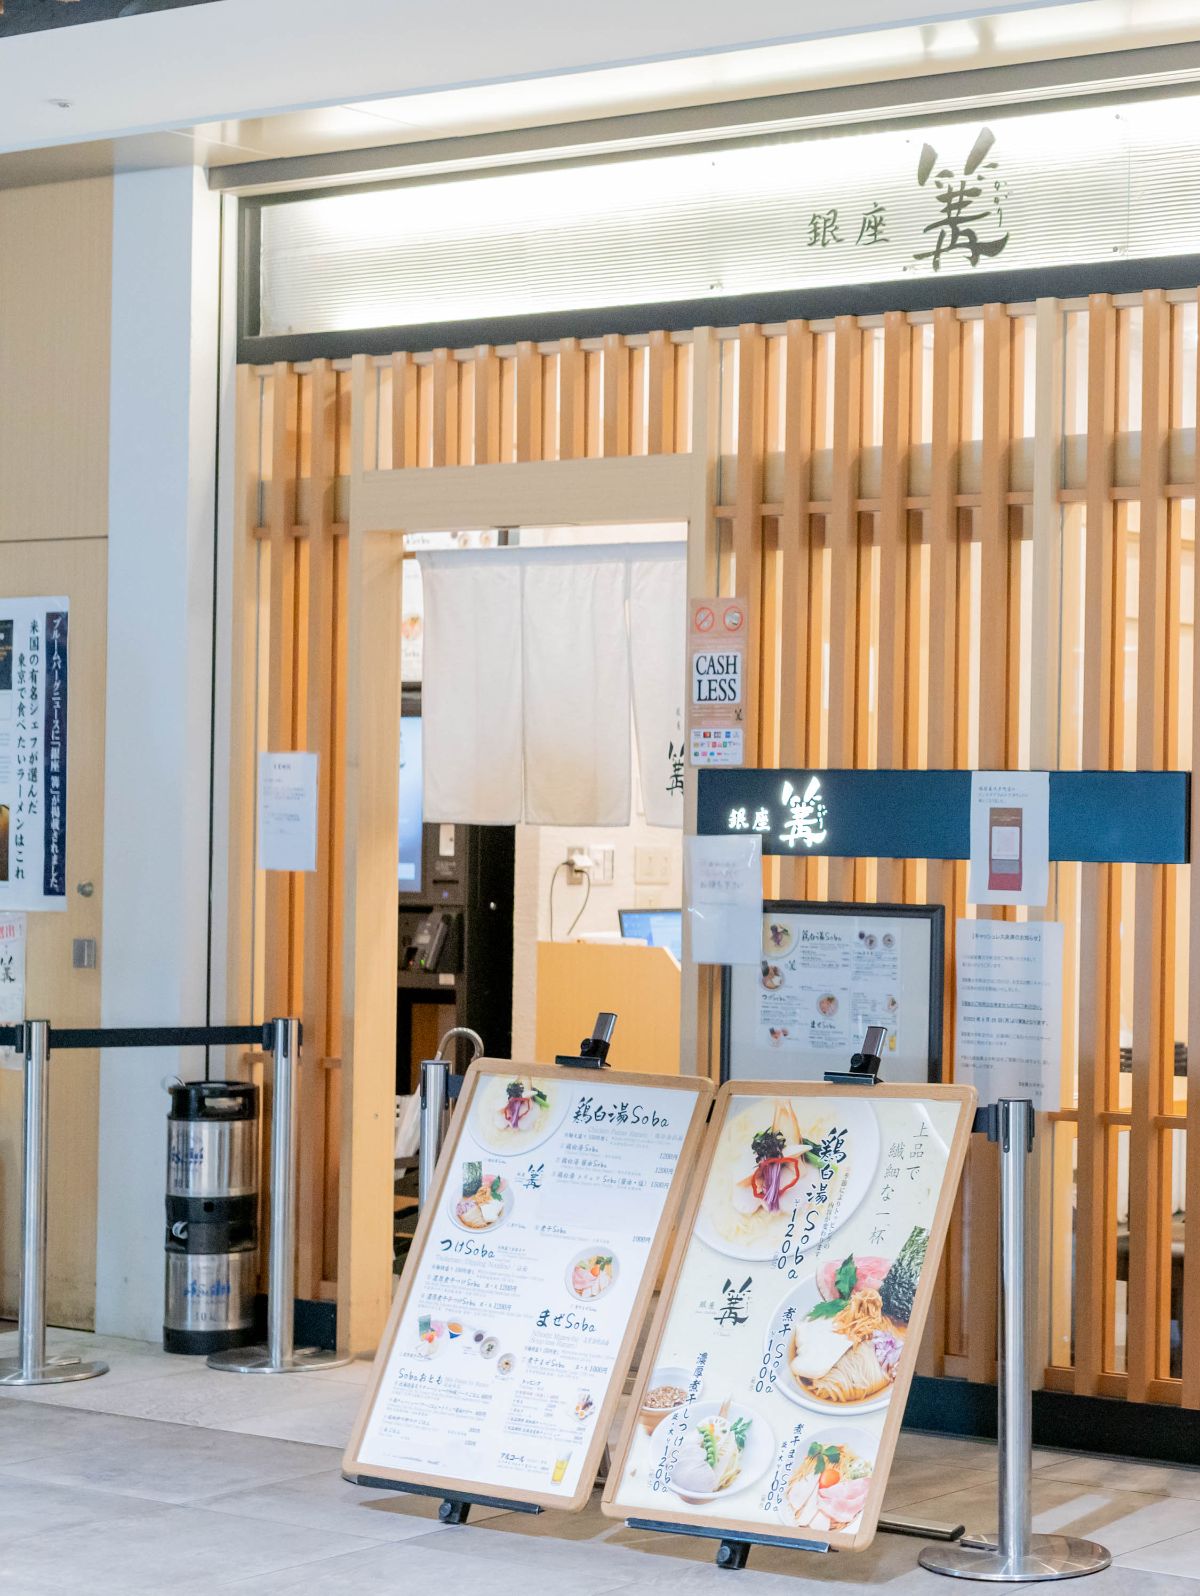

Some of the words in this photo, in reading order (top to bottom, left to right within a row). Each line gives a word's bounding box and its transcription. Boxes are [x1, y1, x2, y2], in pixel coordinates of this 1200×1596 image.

[806, 202, 890, 247] 銀座
[913, 127, 1008, 272] 篝
[695, 654, 738, 676] CASH
[696, 678, 737, 702] LESS
[27, 619, 39, 816] 米国の有名シェフが選んだ
[14, 652, 27, 881] 東京で食べたいラーメンはこれ
[728, 807, 770, 831] 銀座
[778, 775, 827, 848] 篝
[573, 1096, 669, 1128] 鶏白湯Soba
[906, 1121, 929, 1182] 上品で
[869, 1141, 906, 1246] 繊細な一杯
[440, 1238, 495, 1259] つけSoba
[536, 1308, 597, 1333] まぜSoba
[714, 1276, 753, 1327] 篝
